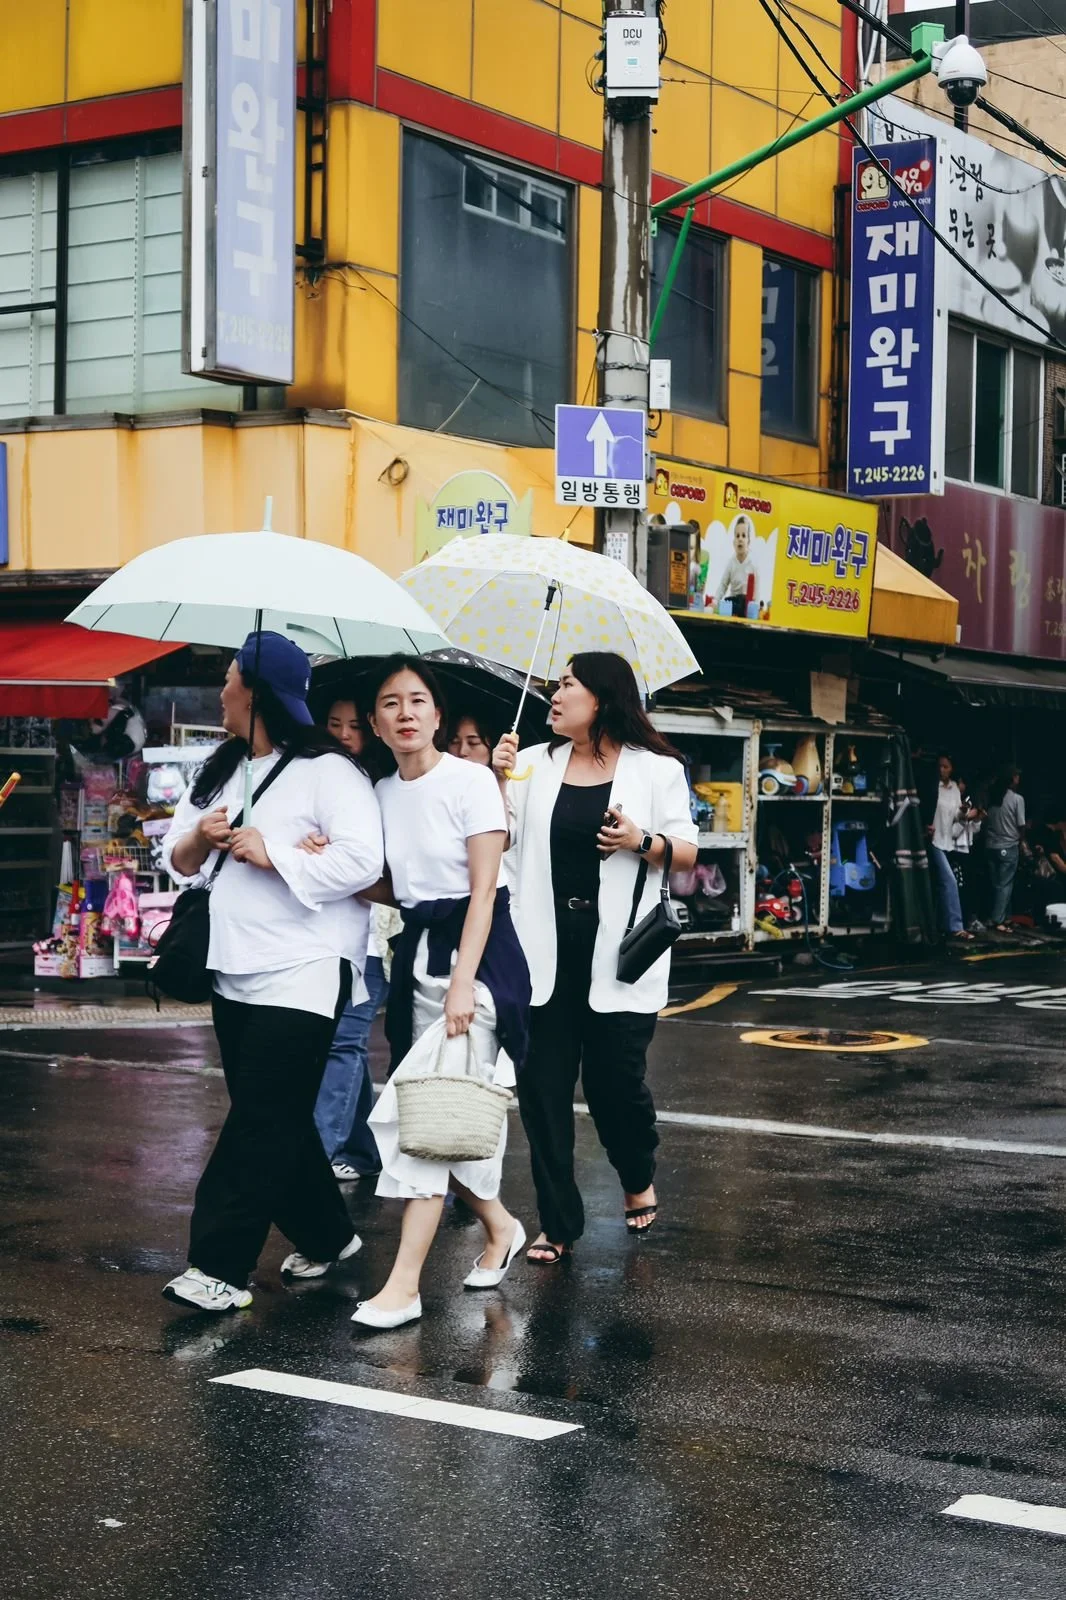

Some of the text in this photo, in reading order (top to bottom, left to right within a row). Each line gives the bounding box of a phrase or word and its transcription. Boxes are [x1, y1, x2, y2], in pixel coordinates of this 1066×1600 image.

[623, 28, 642, 39] DCU
[866, 220, 920, 456] 재미완구
[561, 480, 640, 505] 일방통행
[436, 500, 508, 535] 재미완구
[787, 523, 868, 577] 재미완구
